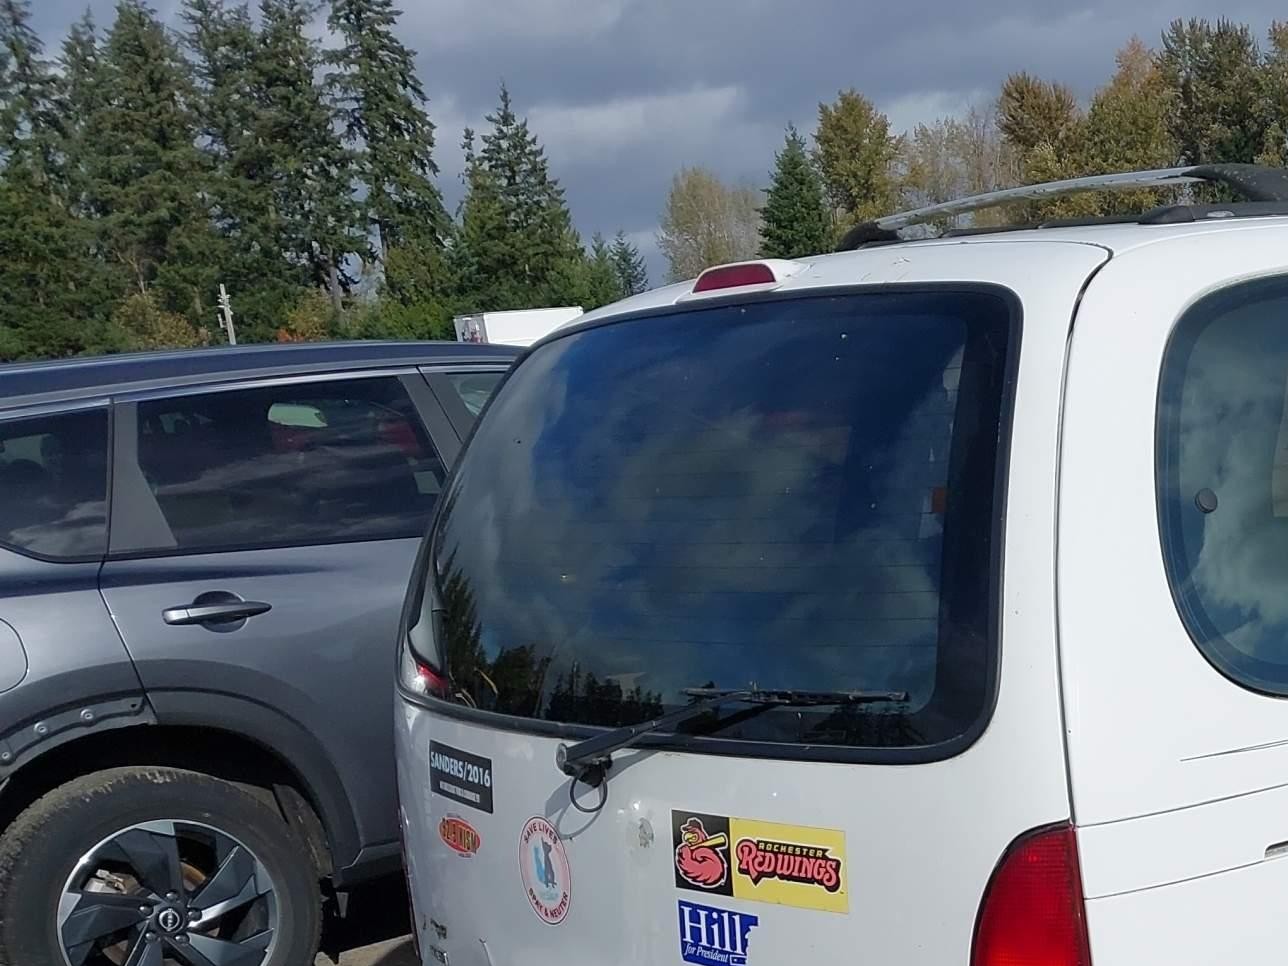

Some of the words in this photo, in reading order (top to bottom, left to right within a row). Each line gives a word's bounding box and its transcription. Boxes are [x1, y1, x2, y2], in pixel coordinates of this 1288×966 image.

[430, 751, 491, 788] SANDERS/2016
[524, 822, 538, 844] SAVE
[538, 823, 558, 844] LIVES
[758, 842, 824, 858] ROCHESTER
[549, 891, 568, 918] NEUTER
[684, 943, 696, 956] for
[696, 946, 729, 963] President
